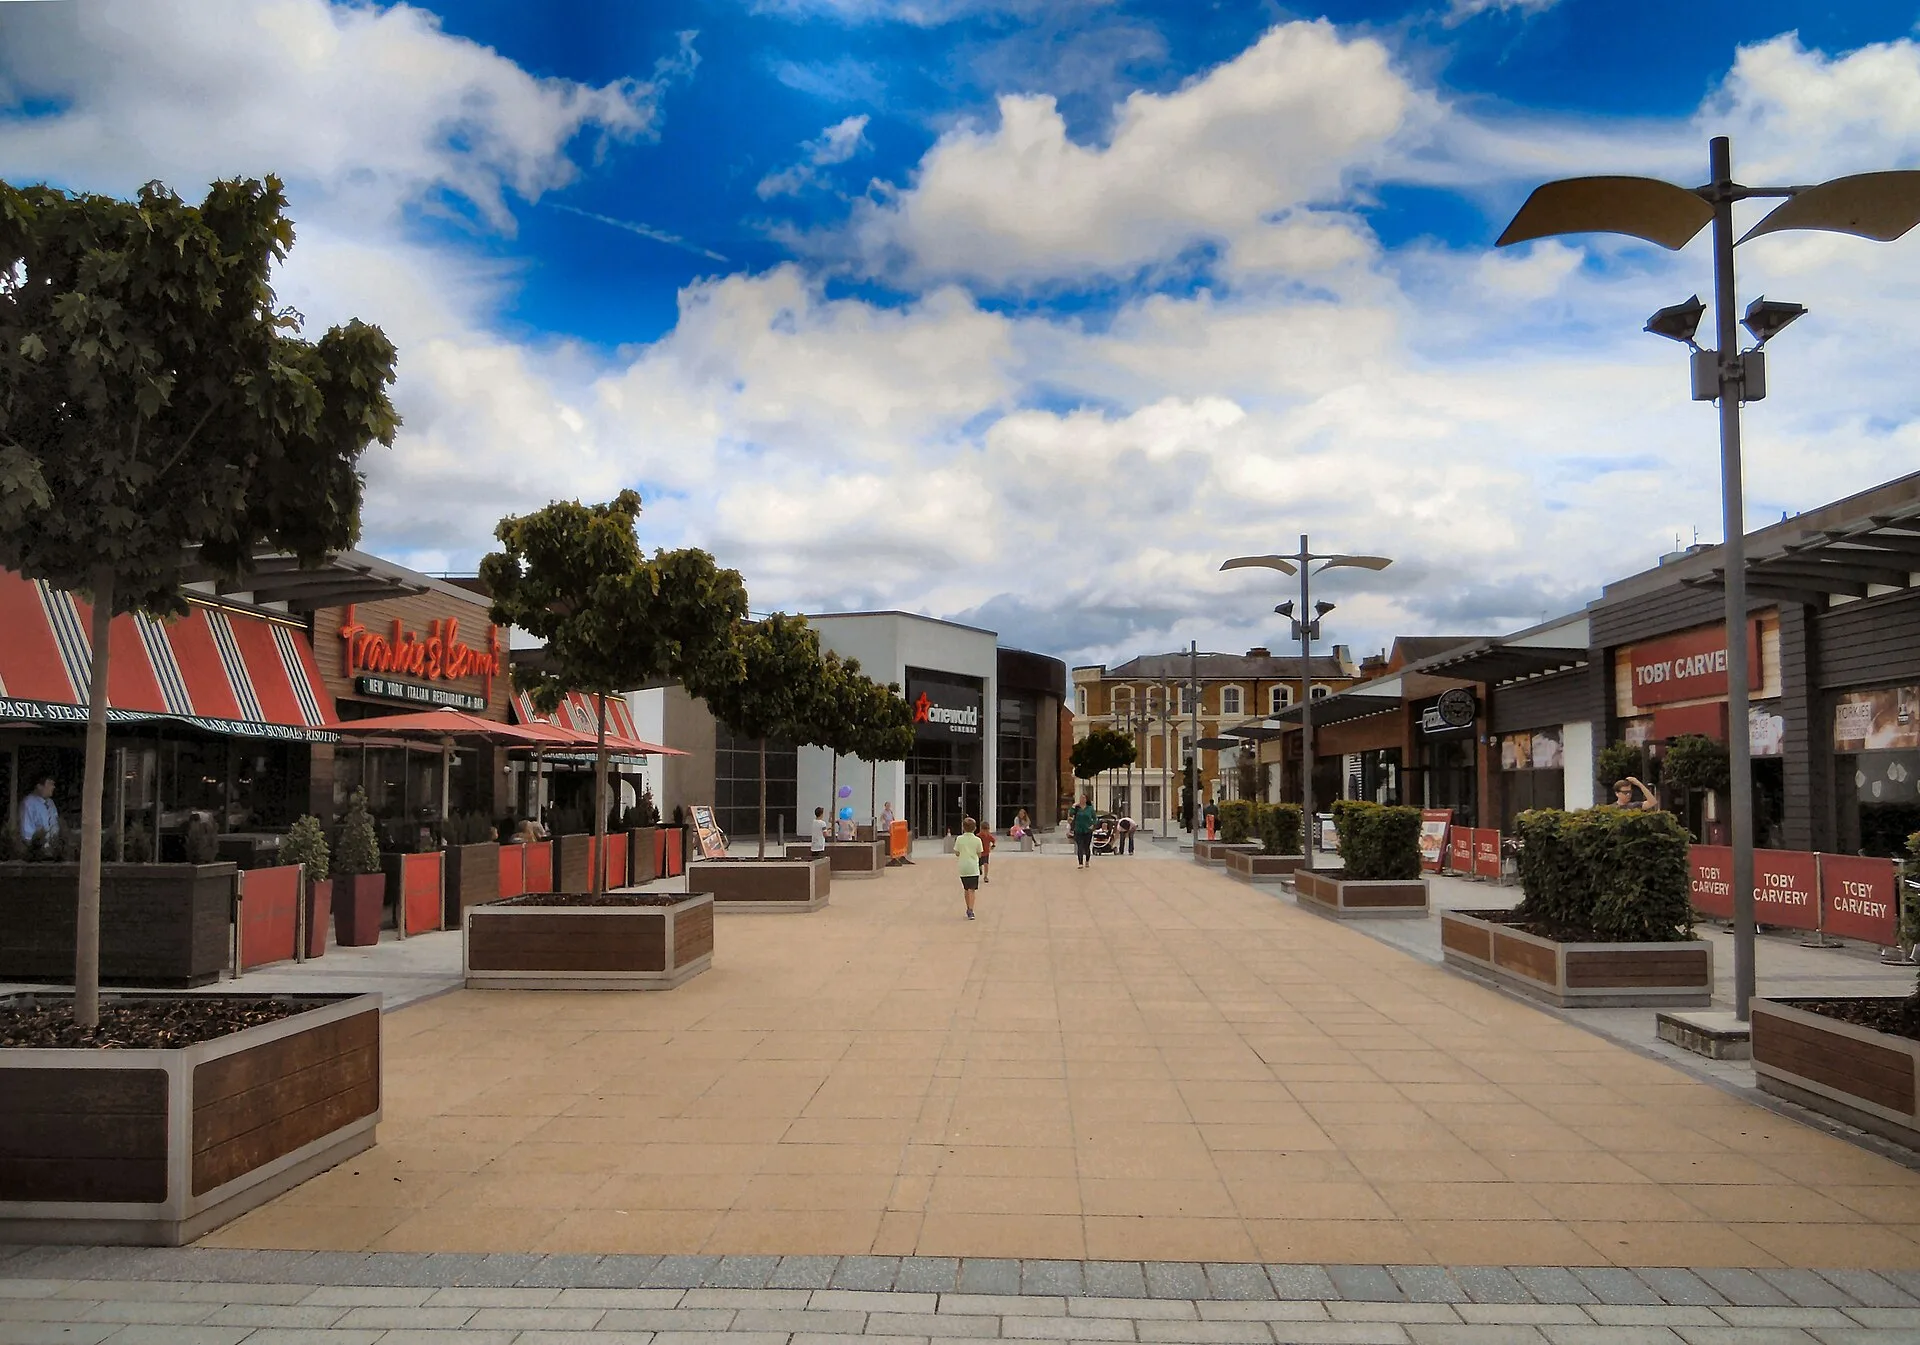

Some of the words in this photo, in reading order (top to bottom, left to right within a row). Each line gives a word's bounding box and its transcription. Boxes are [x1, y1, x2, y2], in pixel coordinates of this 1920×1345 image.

[1635, 661, 1672, 686] TOBY
[1674, 649, 1729, 679] CARVE
[369, 679, 384, 693] NEW
[387, 682, 403, 697] YORK
[407, 686, 429, 701] ITALIAN
[432, 690, 465, 706] RESTAURANT
[474, 697, 484, 710] BAR
[0, 701, 44, 718] PASTA
[232, 721, 265, 736] GRILLS
[927, 703, 977, 726] cineworld
[1699, 866, 1721, 880] TOBY
[1763, 873, 1795, 889] TOBY
[1691, 880, 1730, 896] CARVERY
[1753, 888, 1808, 906] CARVERY
[1842, 880, 1873, 898] TOBY
[1834, 896, 1887, 918] CARVERY
